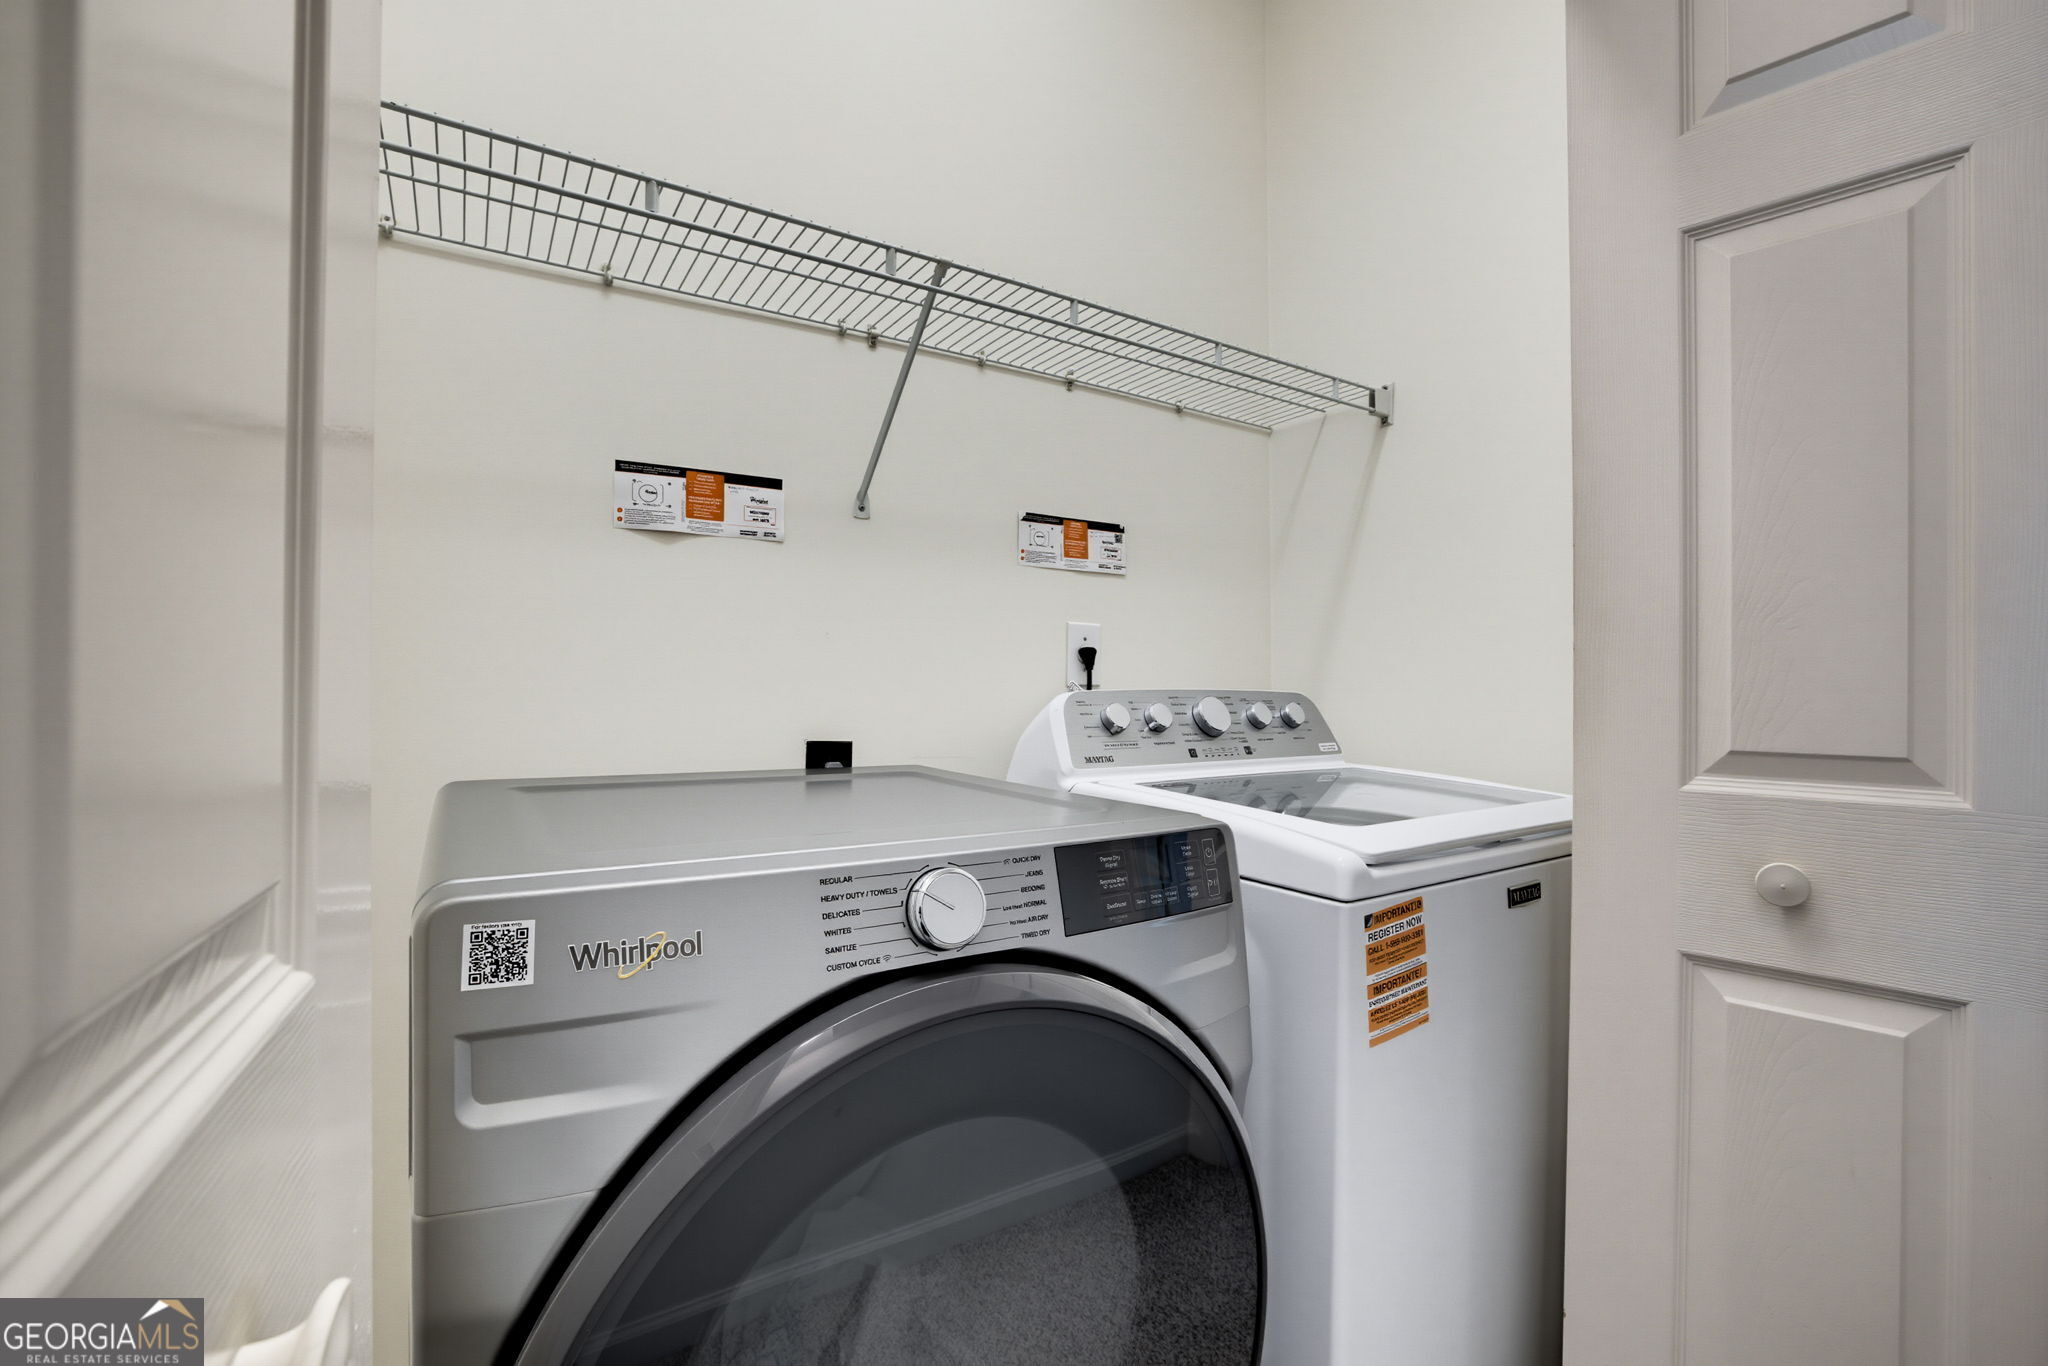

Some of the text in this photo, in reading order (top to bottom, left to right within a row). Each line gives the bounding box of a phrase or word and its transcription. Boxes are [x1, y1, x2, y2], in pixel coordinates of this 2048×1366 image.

[1084, 755, 1114, 763] MAYTAG
[1012, 856, 1029, 864] QUICK
[820, 876, 853, 886] REGULAR
[1021, 884, 1045, 893] BEDDING
[820, 893, 845, 902] HEAVY
[845, 890, 865, 900] DUTY
[870, 887, 898, 897] TOWELS
[1024, 899, 1047, 908] NORMAL
[822, 908, 861, 920] DELICATES
[1038, 914, 1049, 922] DRY
[824, 927, 852, 937] WHITES
[1039, 928, 1050, 937] DRY
[1368, 914, 1422, 942] REGISTER NOW
[567, 929, 703, 972] Whirlpool
[825, 943, 857, 954] SANITIZE
[826, 957, 881, 972] CUSTOM CYCLE
